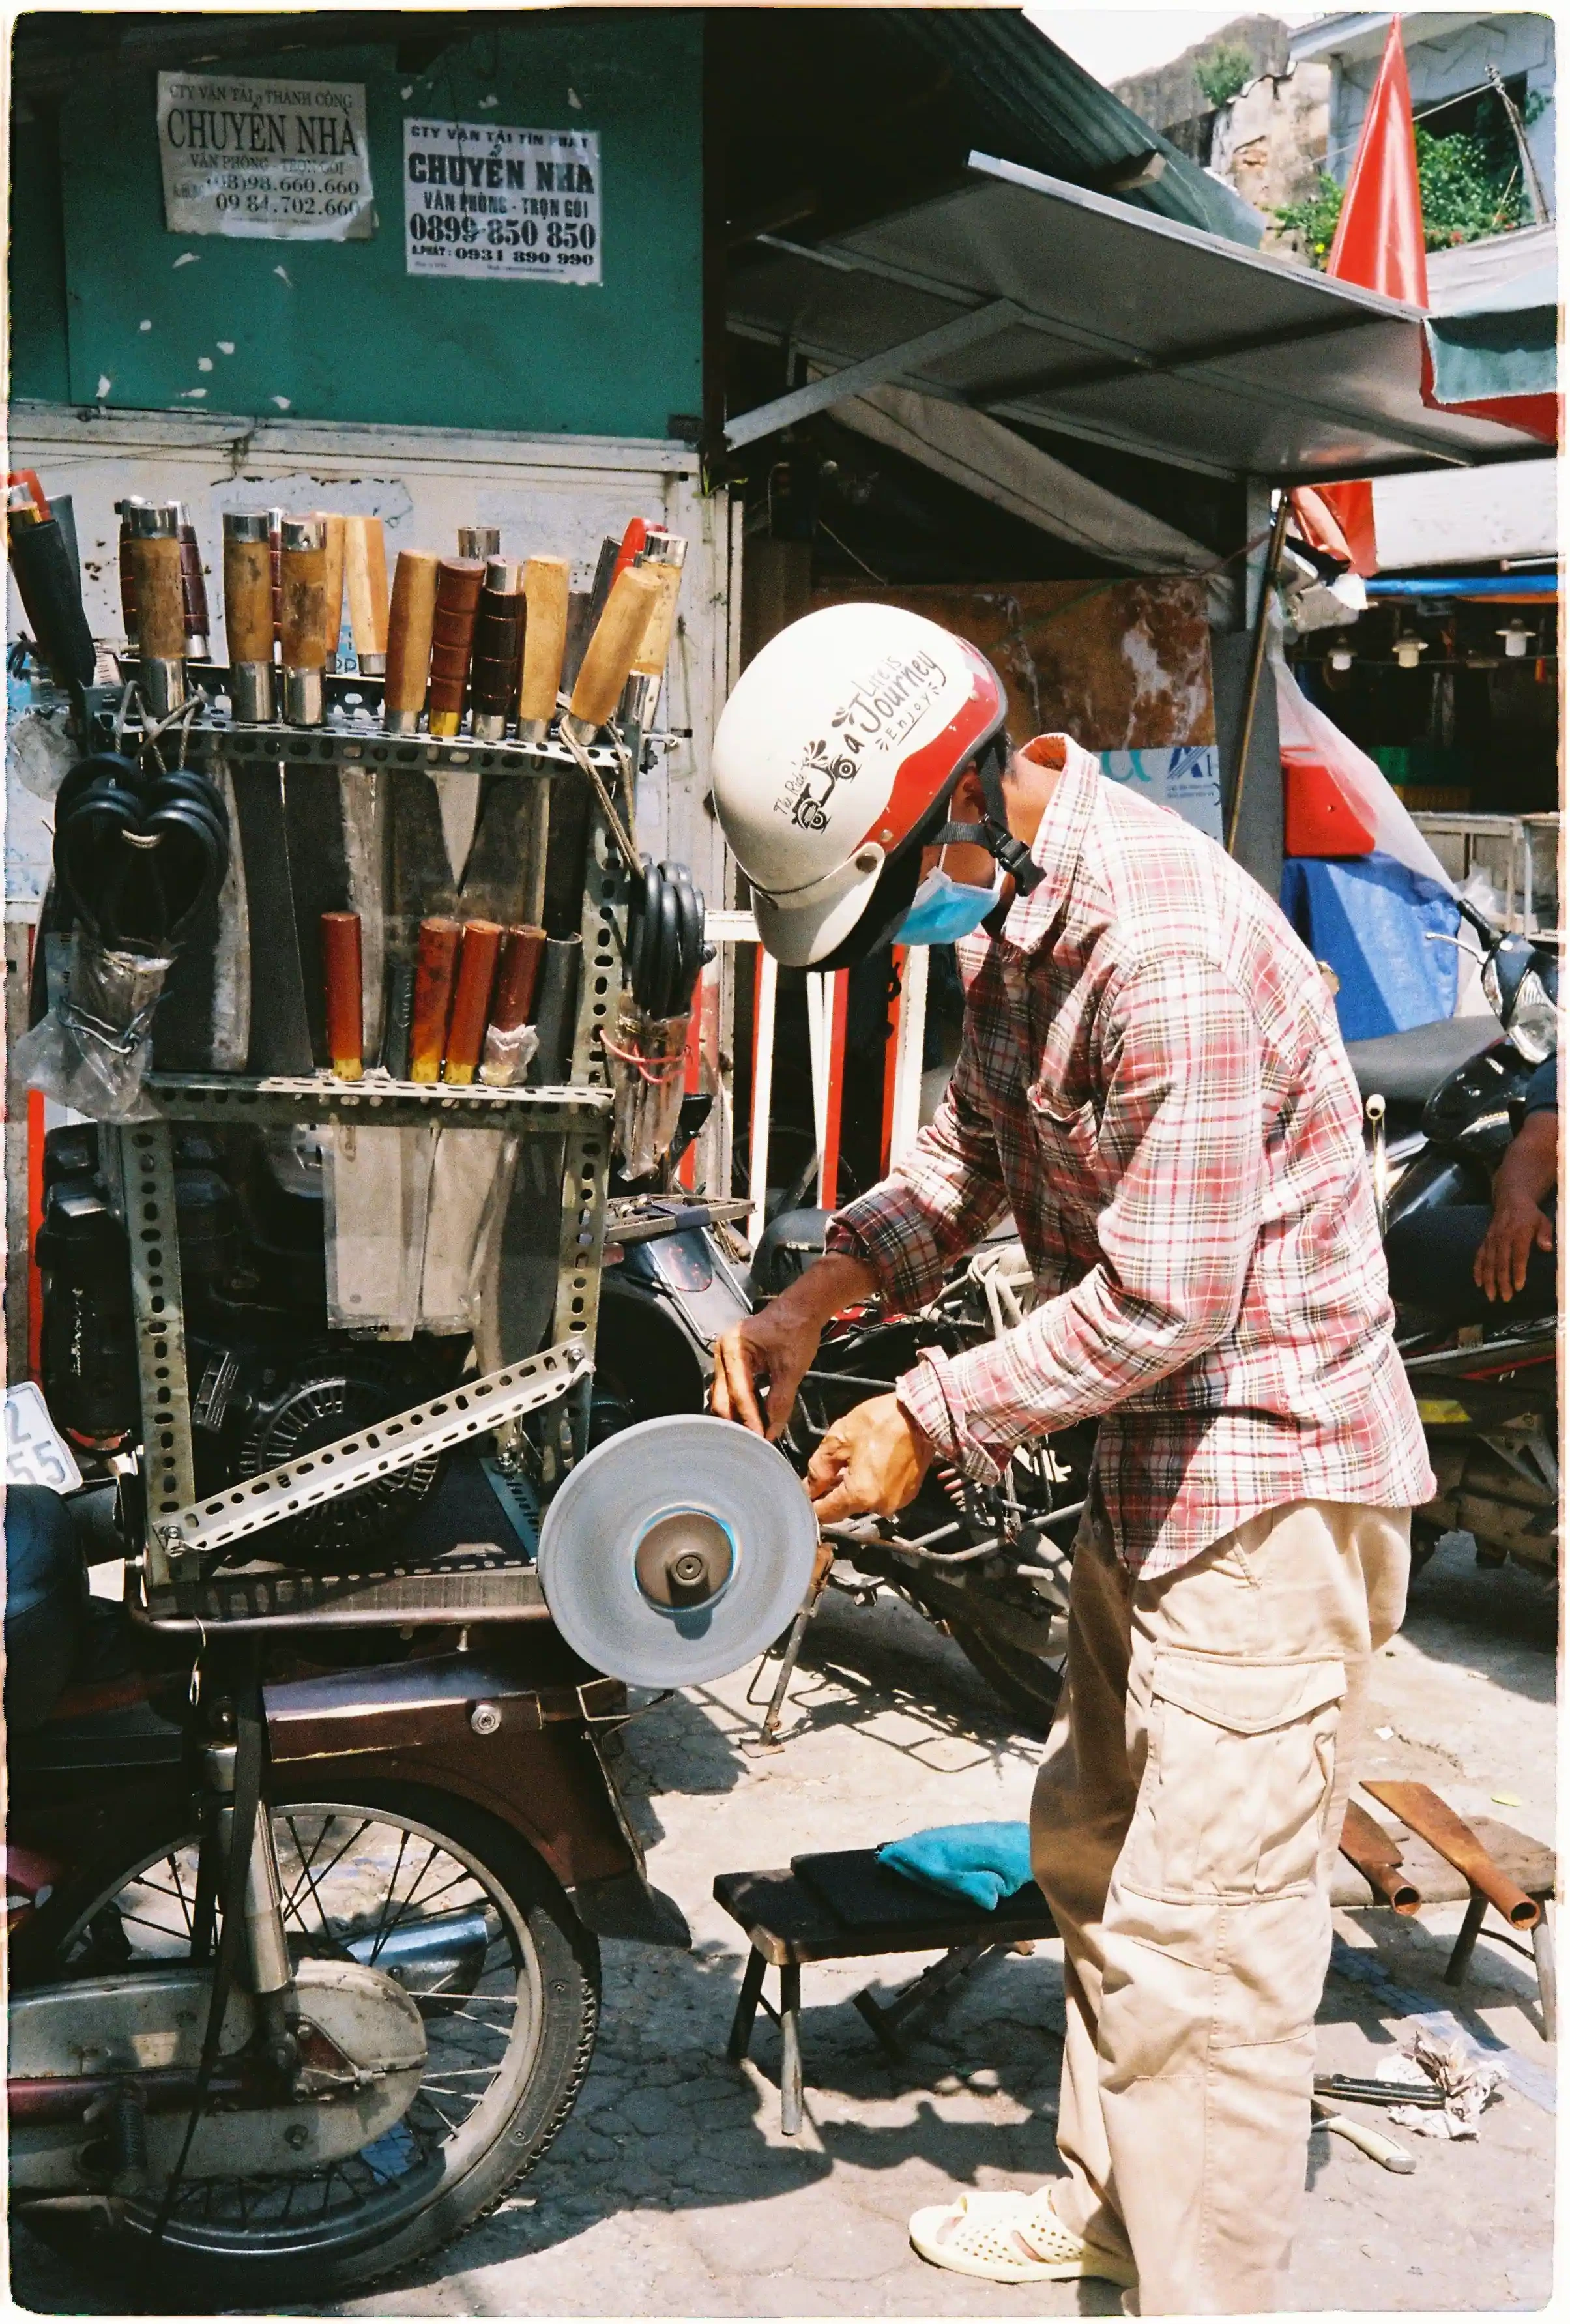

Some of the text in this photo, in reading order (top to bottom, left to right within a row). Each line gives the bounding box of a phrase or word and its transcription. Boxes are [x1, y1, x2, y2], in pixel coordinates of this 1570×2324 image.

[296, 106, 358, 156] NHÀ
[487, 218, 539, 247] 850
[546, 222, 596, 250] 850
[849, 650, 947, 733] Journey
